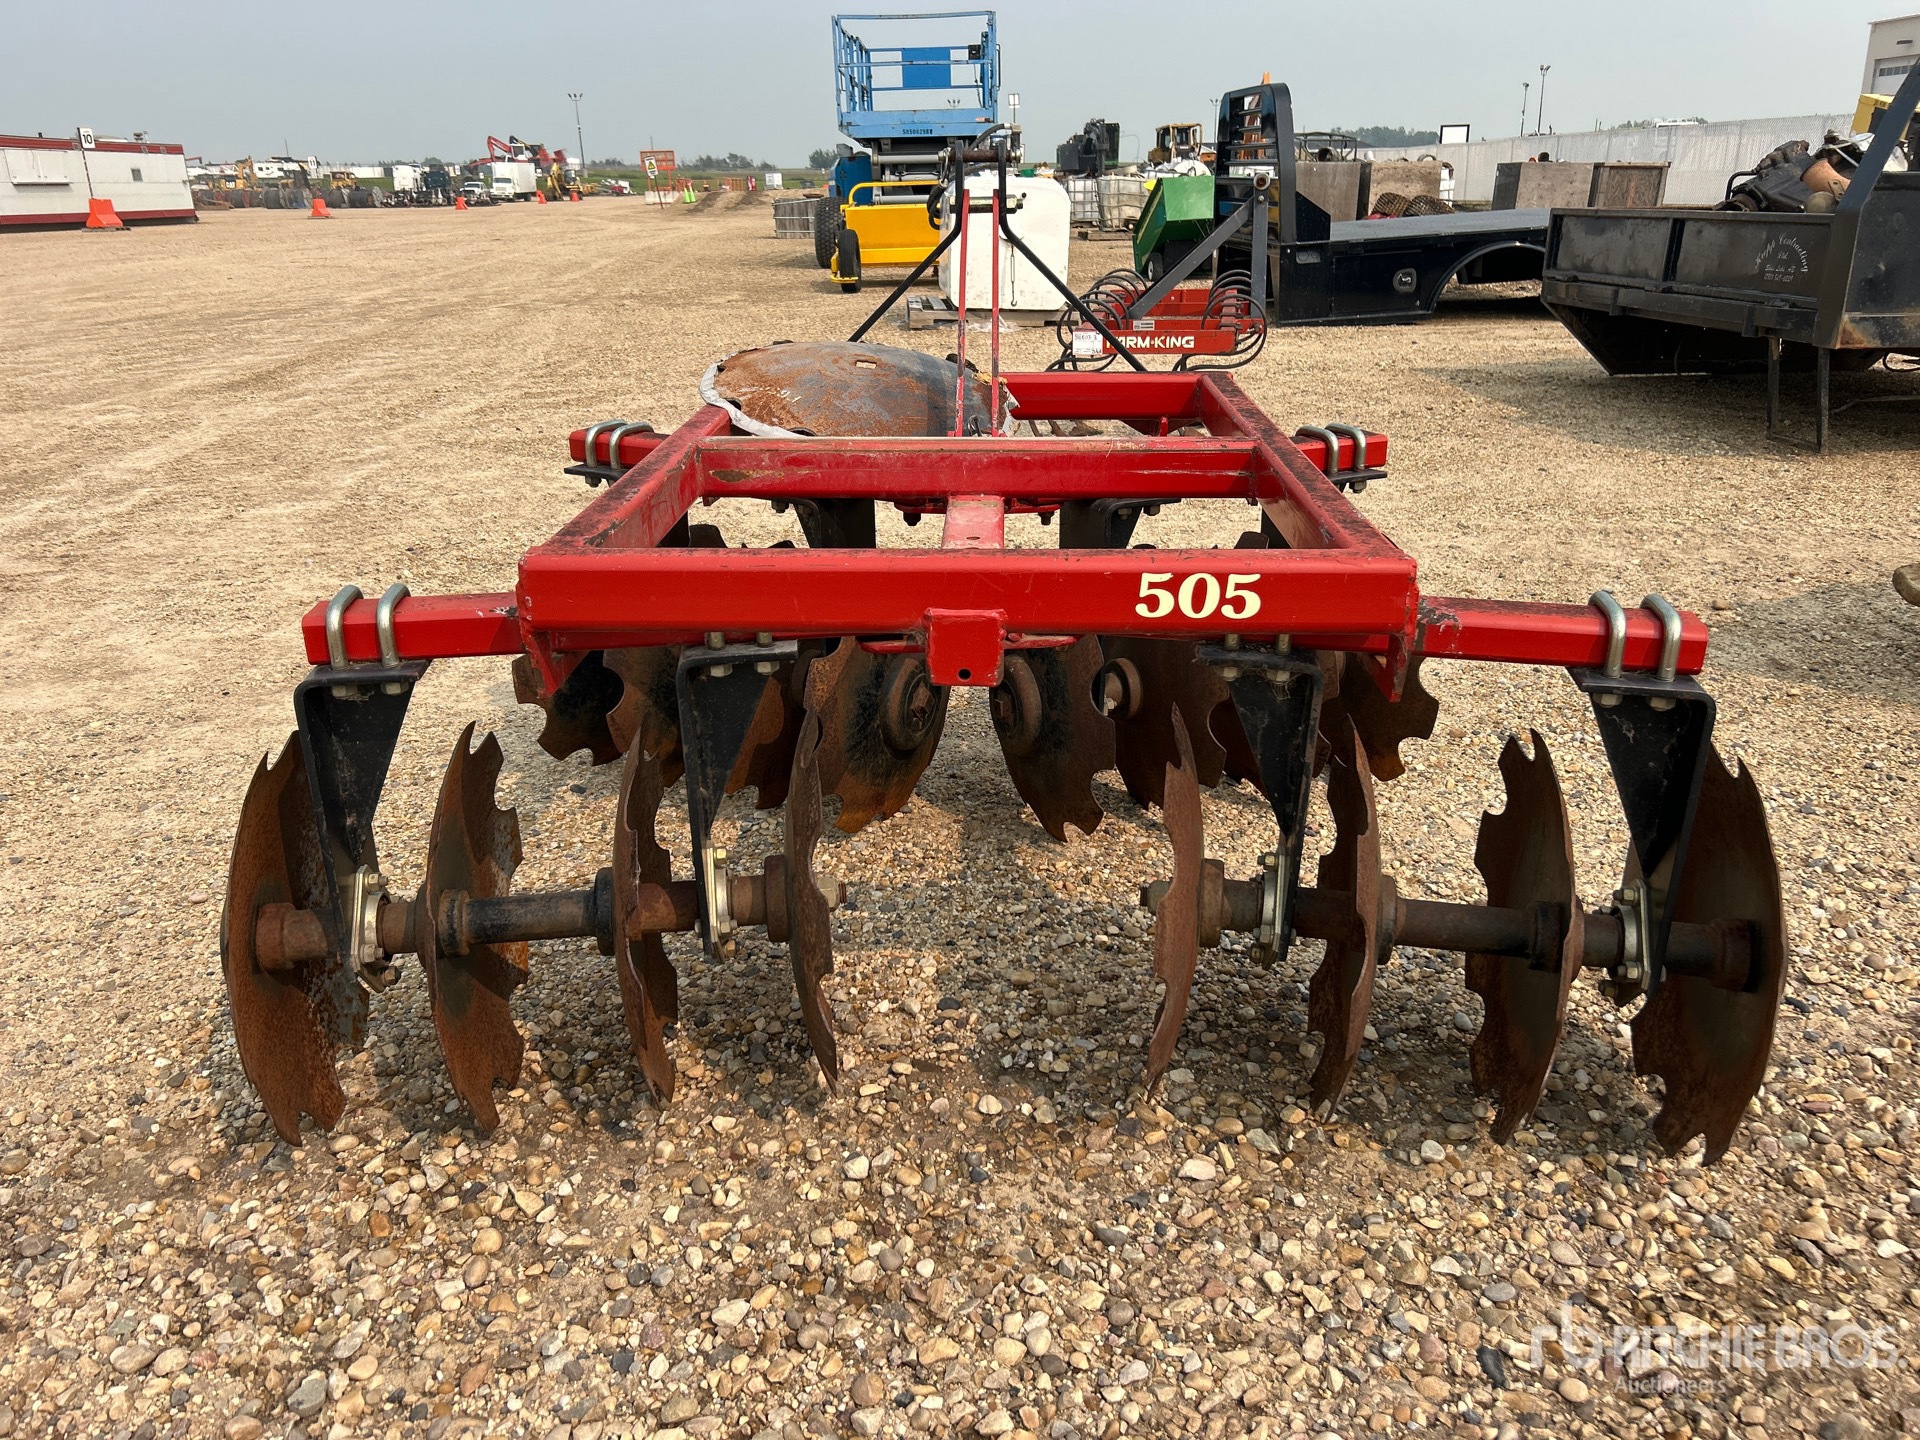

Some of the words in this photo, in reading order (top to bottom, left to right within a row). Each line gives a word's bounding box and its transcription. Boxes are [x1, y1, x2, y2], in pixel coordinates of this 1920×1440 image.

[82, 134, 93, 144] 10
[1778, 232, 1808, 272] Contracting
[1135, 573, 1262, 619] 505
